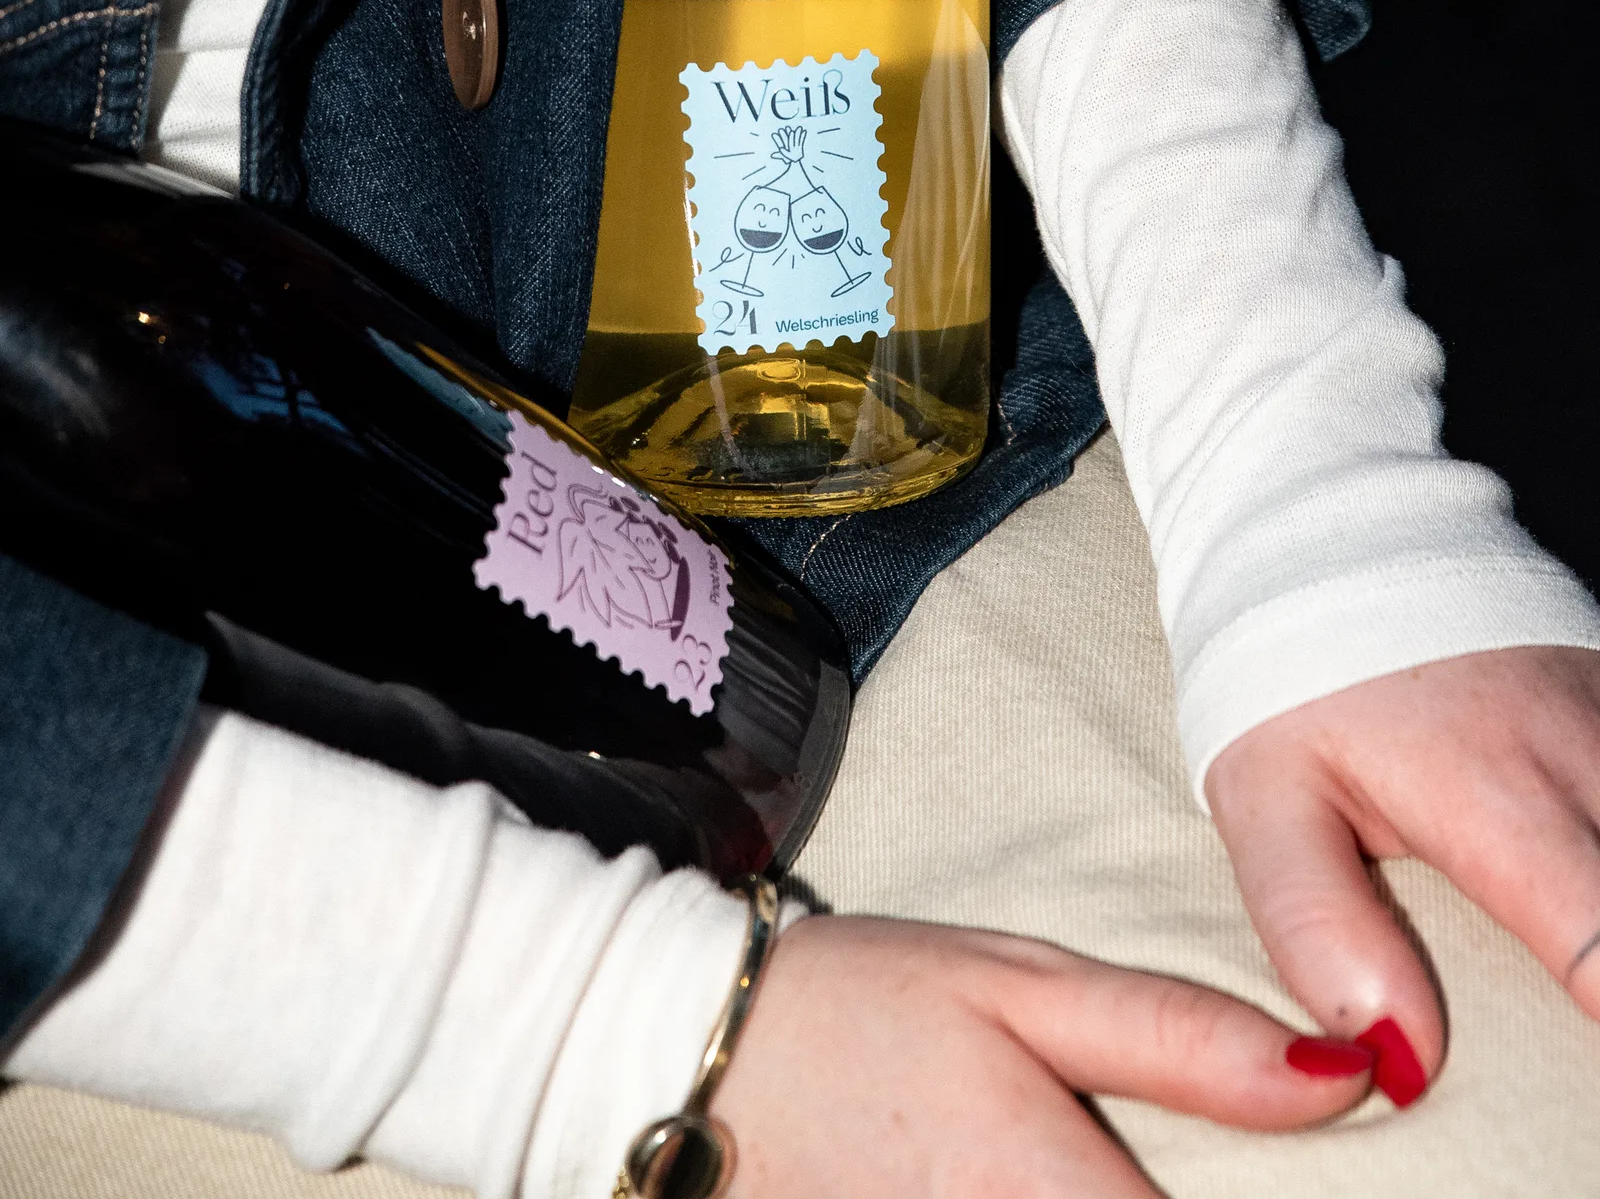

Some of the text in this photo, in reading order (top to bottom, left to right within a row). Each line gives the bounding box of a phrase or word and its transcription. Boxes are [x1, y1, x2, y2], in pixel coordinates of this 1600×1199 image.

[711, 69, 851, 123] Weiß
[712, 300, 761, 335] 24
[775, 309, 880, 333] Welschriesling
[506, 451, 558, 556] Red
[673, 633, 712, 691] 23
